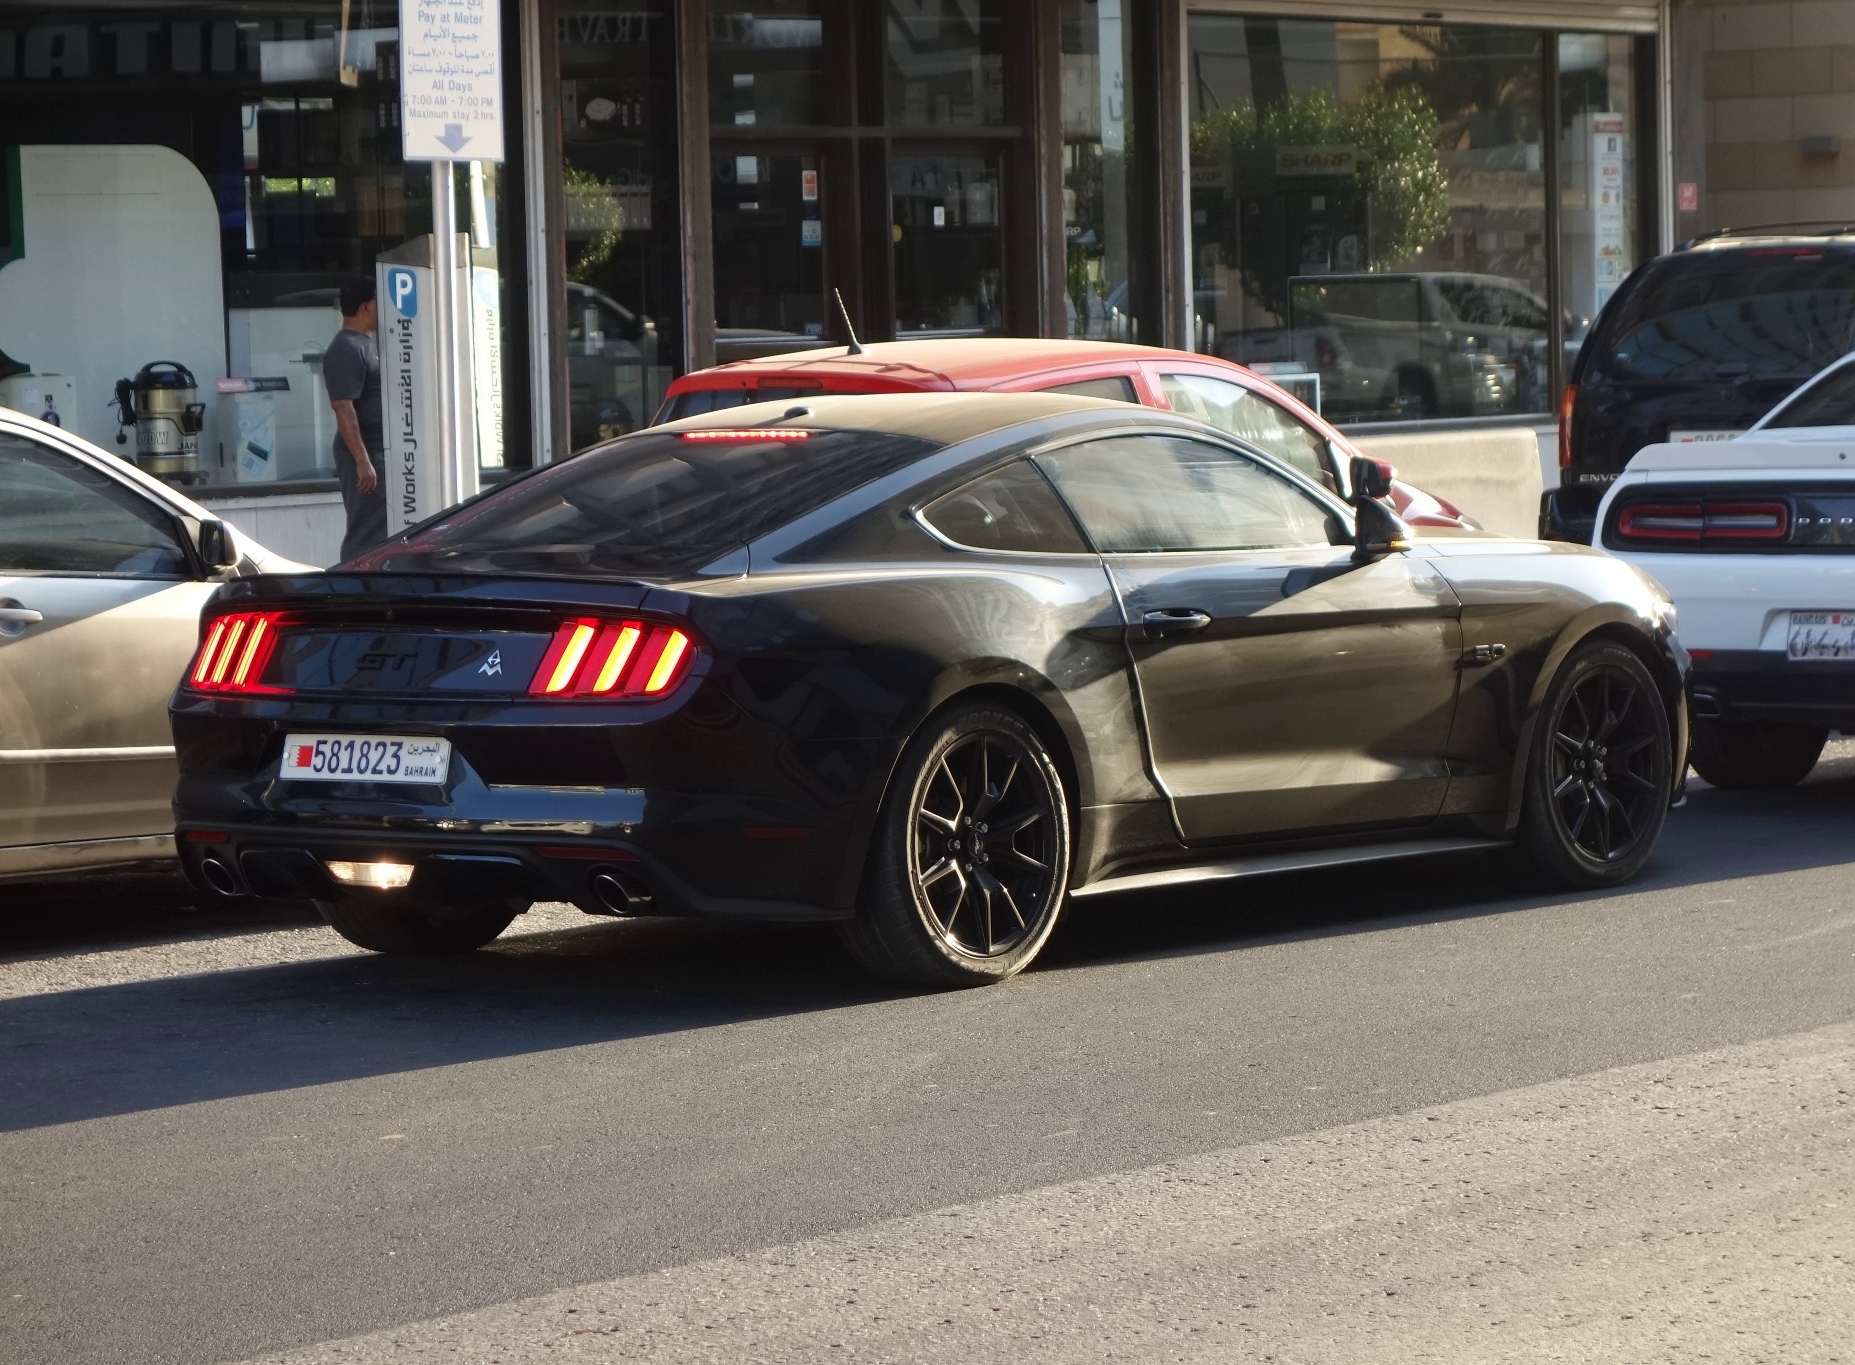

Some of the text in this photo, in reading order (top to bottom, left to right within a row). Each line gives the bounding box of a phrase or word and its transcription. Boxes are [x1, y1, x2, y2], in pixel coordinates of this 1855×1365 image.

[417, 10, 483, 24] Pay at Meter
[423, 24, 479, 43] جميع الأيام
[460, 64, 474, 74] مدة
[432, 80, 473, 93] All Days
[411, 95, 432, 105] 7:00
[434, 96, 447, 105] AM
[458, 96, 479, 106] 7:00
[480, 97, 493, 107] PM
[408, 108, 497, 121] Maximum stay 2 hrs.
[1281, 151, 1352, 168] SHARP
[395, 272, 414, 309] P
[397, 318, 414, 363] وزارة
[402, 451, 417, 512] Works
[355, 651, 418, 671] GT
[312, 739, 404, 775] 581823
[407, 742, 440, 757] البحرين
[404, 765, 437, 778] BAHRAIN
